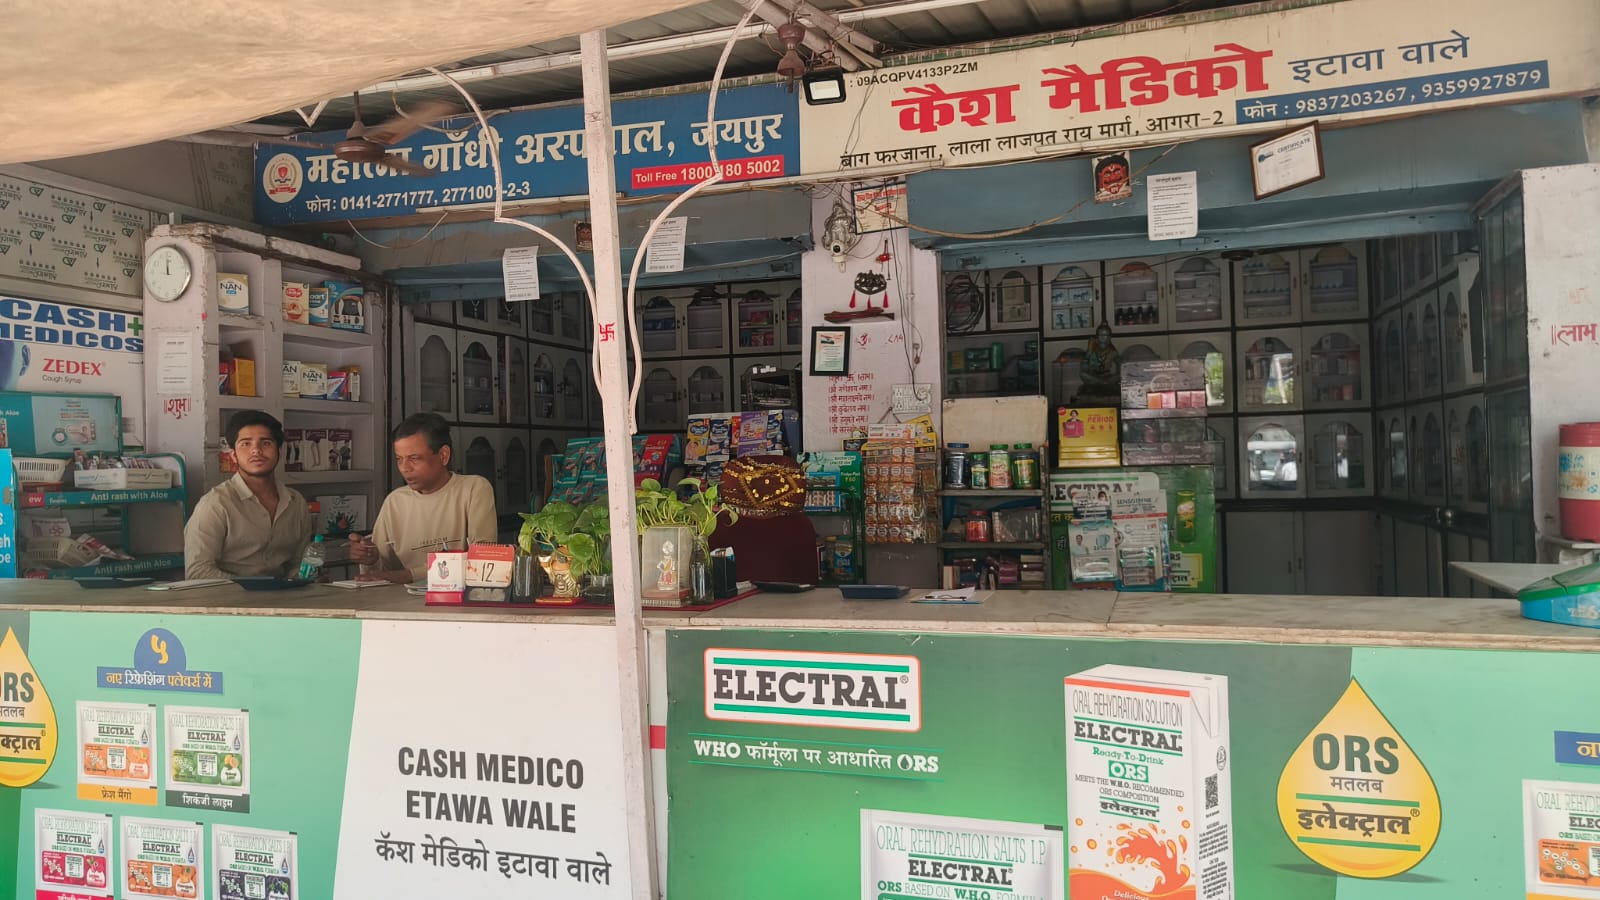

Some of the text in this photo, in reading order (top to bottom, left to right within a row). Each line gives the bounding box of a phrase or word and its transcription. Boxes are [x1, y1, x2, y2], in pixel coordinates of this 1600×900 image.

[1288, 30, 1470, 84] इटावा वाले
[891, 43, 1273, 133] कैश मैडिको
[1421, 69, 1542, 98] 9359927879
[948, 138, 991, 156] लाला
[996, 130, 1056, 151] लाजपत
[1064, 125, 1092, 140] राय
[635, 172, 653, 184] Toll
[655, 171, 677, 183] Free
[680, 166, 712, 181] 1800
[746, 159, 780, 175] 5002
[340, 189, 438, 211] 0141-2771777,
[220, 283, 242, 291] NAN
[0, 299, 126, 333] CASH
[42, 358, 103, 376] ZEDEX
[282, 365, 297, 373] AN
[42, 375, 64, 383] Cough
[91, 490, 168, 502] Anti rash with Aloe
[94, 558, 172, 575] Anti rash with Aloe
[481, 562, 495, 583] 12
[0, 671, 35, 703] RS
[106, 672, 122, 684] नए
[203, 671, 213, 688] में
[713, 668, 907, 710] ELECTRAL
[1073, 689, 1183, 727] ORAL REHYDRATION SOLUTION
[98, 726, 134, 735] ELECTRAL
[187, 731, 225, 741] ELECTRAL
[1074, 721, 1183, 752] ELECTRAL
[0, 733, 42, 754] क्ट्राल
[1312, 732, 1399, 775] ORS
[693, 739, 939, 773] WHO फॉर्मूला पर आधारित ORS
[1092, 746, 1164, 765] Ready-To-Drink
[398, 746, 584, 789] CASH MEDICO
[1110, 762, 1147, 781] ORS
[1096, 777, 1109, 785] THE
[1132, 783, 1184, 798] RECOMMENDED
[1099, 787, 1159, 803] ORS COMPOSITION
[1329, 776, 1384, 793] मतलब
[212, 797, 233, 809] लाइम
[406, 790, 576, 833] ETAWA WALE
[1537, 792, 1561, 810] ORAL
[56, 833, 92, 845] ELECTRAL
[143, 842, 180, 853] ELECTRAL
[877, 825, 906, 851] ORAL
[910, 828, 990, 859] REHYDRATION
[994, 835, 1026, 863] SALTS
[235, 851, 273, 864] ELECTRAL
[421, 833, 489, 871] मेडिको
[496, 850, 559, 879] इटावा
[566, 851, 612, 886] वाले
[908, 859, 1013, 885] ELECTRAL
[878, 880, 902, 893] ORS
[904, 882, 934, 897] BASED
[935, 886, 950, 898] ON
